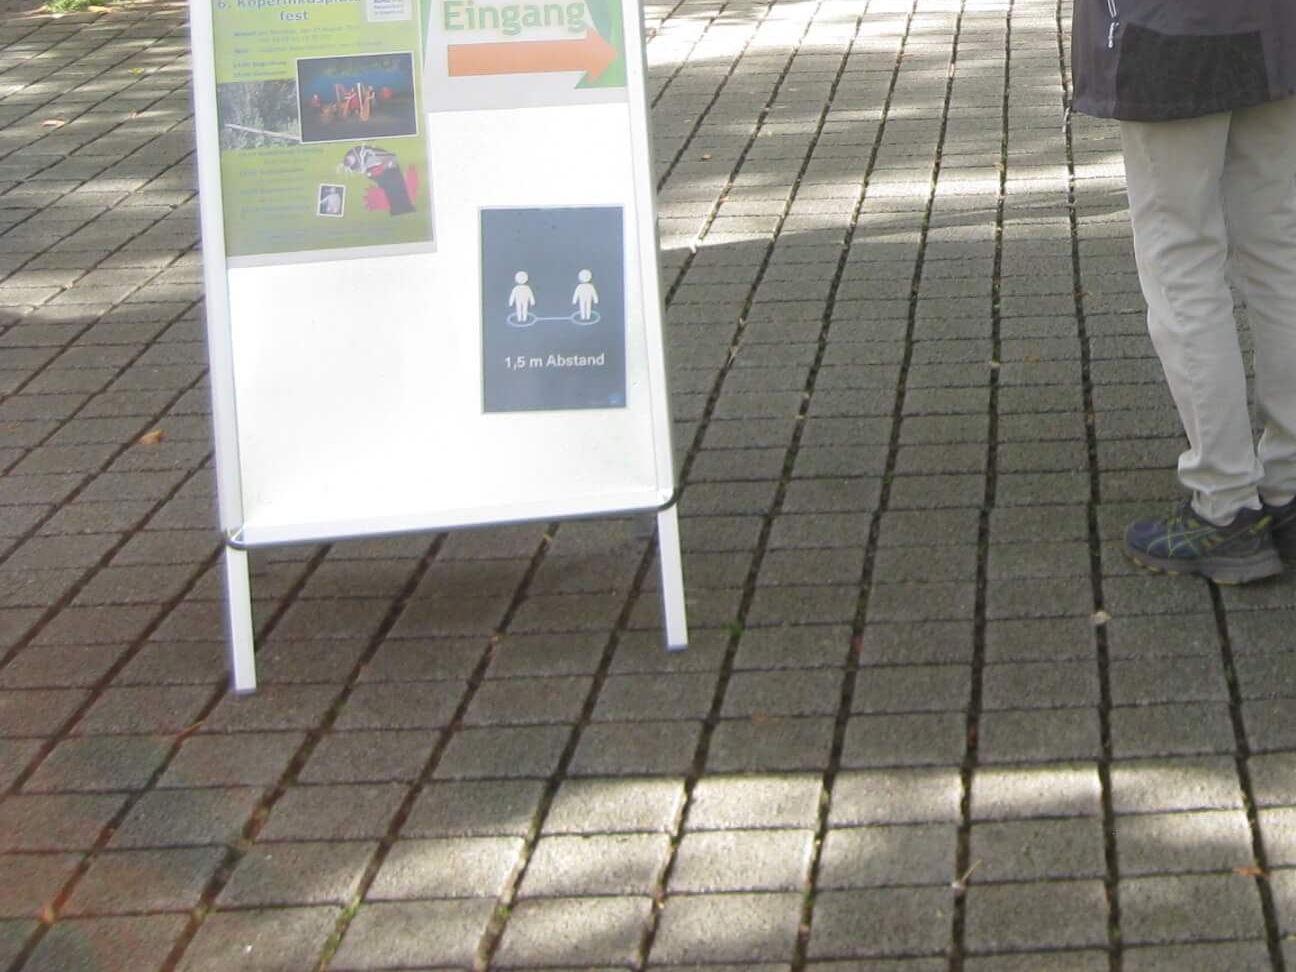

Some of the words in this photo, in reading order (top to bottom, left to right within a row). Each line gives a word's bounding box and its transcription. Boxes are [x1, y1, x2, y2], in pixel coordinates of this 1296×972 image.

[279, 10, 309, 21] fest
[443, 0, 586, 36] Eingang
[504, 355, 526, 371] 1,5
[529, 356, 543, 368] m
[545, 353, 606, 367] Abstand
